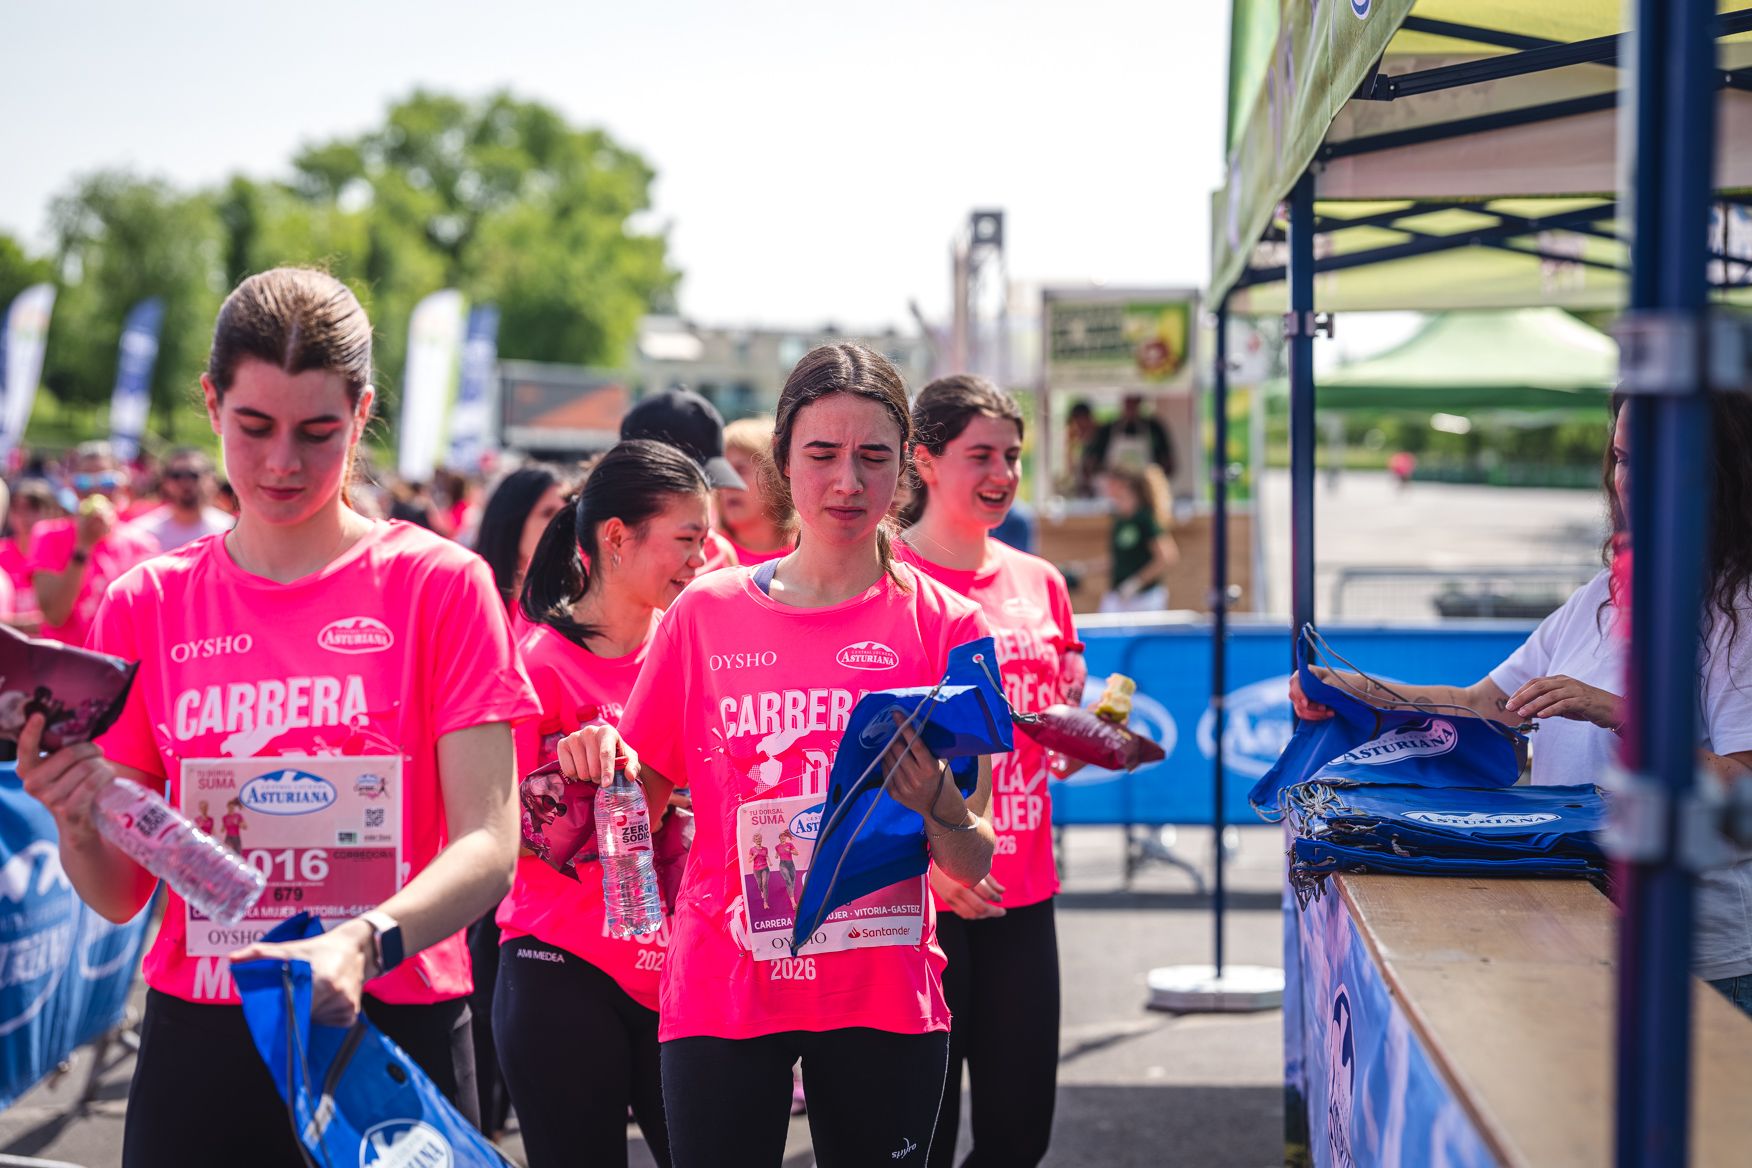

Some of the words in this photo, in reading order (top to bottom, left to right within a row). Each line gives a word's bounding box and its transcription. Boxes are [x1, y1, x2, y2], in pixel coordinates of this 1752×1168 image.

[171, 634, 252, 663] OYSHO
[709, 651, 777, 671] OYSHO
[841, 651, 895, 666] ASTURIANA
[174, 674, 368, 742] CARRERA
[719, 688, 871, 739] CARRER
[1343, 728, 1453, 761] ASTURIANA
[198, 778, 236, 790] SUMA
[247, 786, 330, 803] ASTURIANA
[751, 814, 785, 825] SUMA
[992, 795, 1043, 831] JER
[1417, 814, 1547, 824] ASTURIANA
[622, 823, 649, 836] ZERO
[273, 887, 303, 902] 679
[825, 911, 848, 921] UJER
[854, 904, 920, 917] VITORIA-GASTEIZ
[754, 918, 792, 930] CARRERA
[862, 926, 910, 938] Santander
[771, 932, 827, 949] OYO
[516, 948, 533, 959] AMI
[533, 949, 565, 964] MEDEA
[634, 949, 665, 972] 202
[770, 957, 816, 981] 2026
